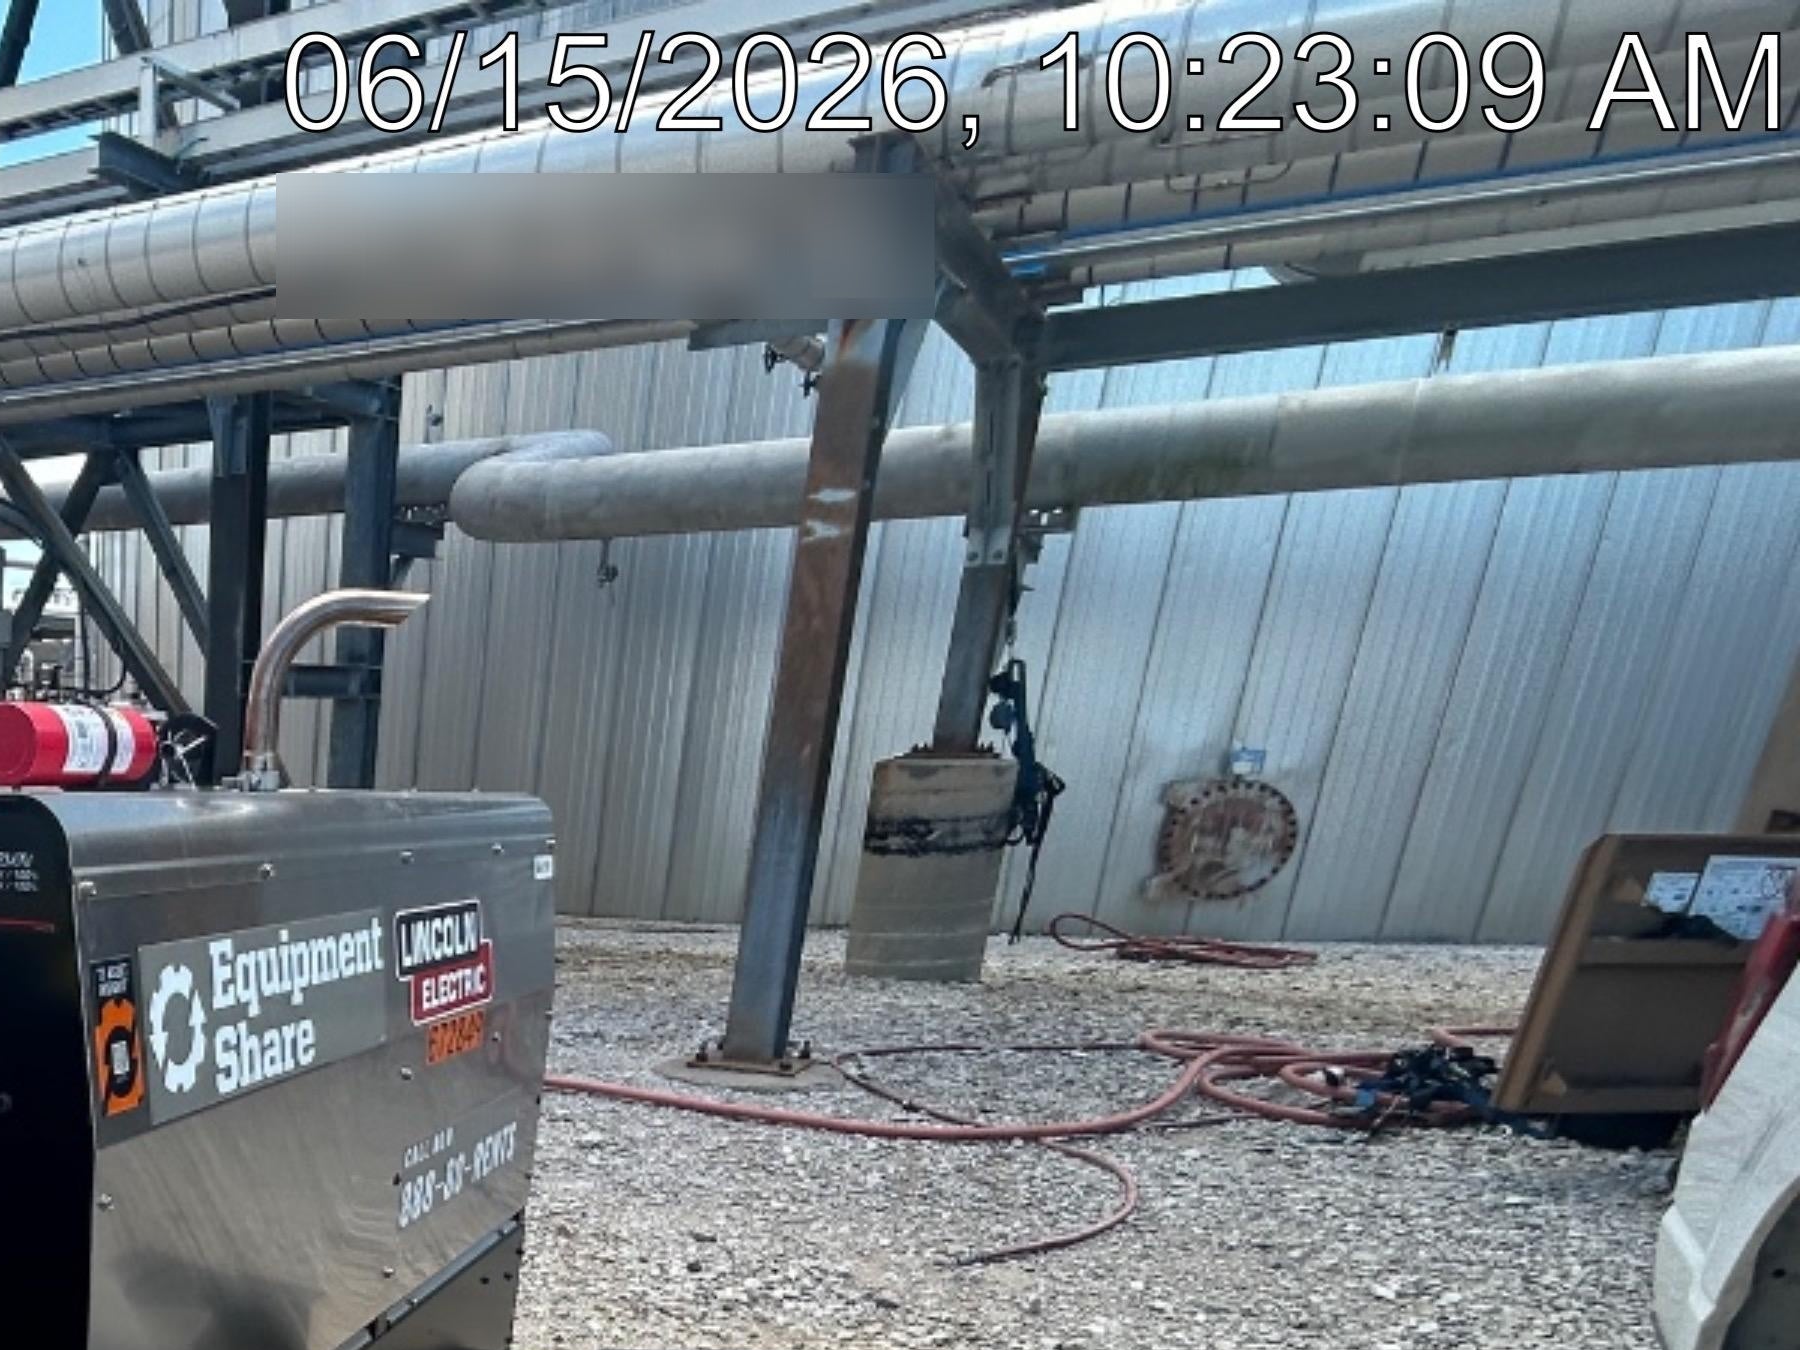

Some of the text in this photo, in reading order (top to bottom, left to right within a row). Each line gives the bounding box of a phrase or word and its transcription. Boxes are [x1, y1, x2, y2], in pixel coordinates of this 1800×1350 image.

[209, 917, 385, 1018] Equipment
[401, 911, 479, 967] LINCOLN
[422, 963, 486, 1011] ELECTRIC
[215, 1018, 317, 1094] Share
